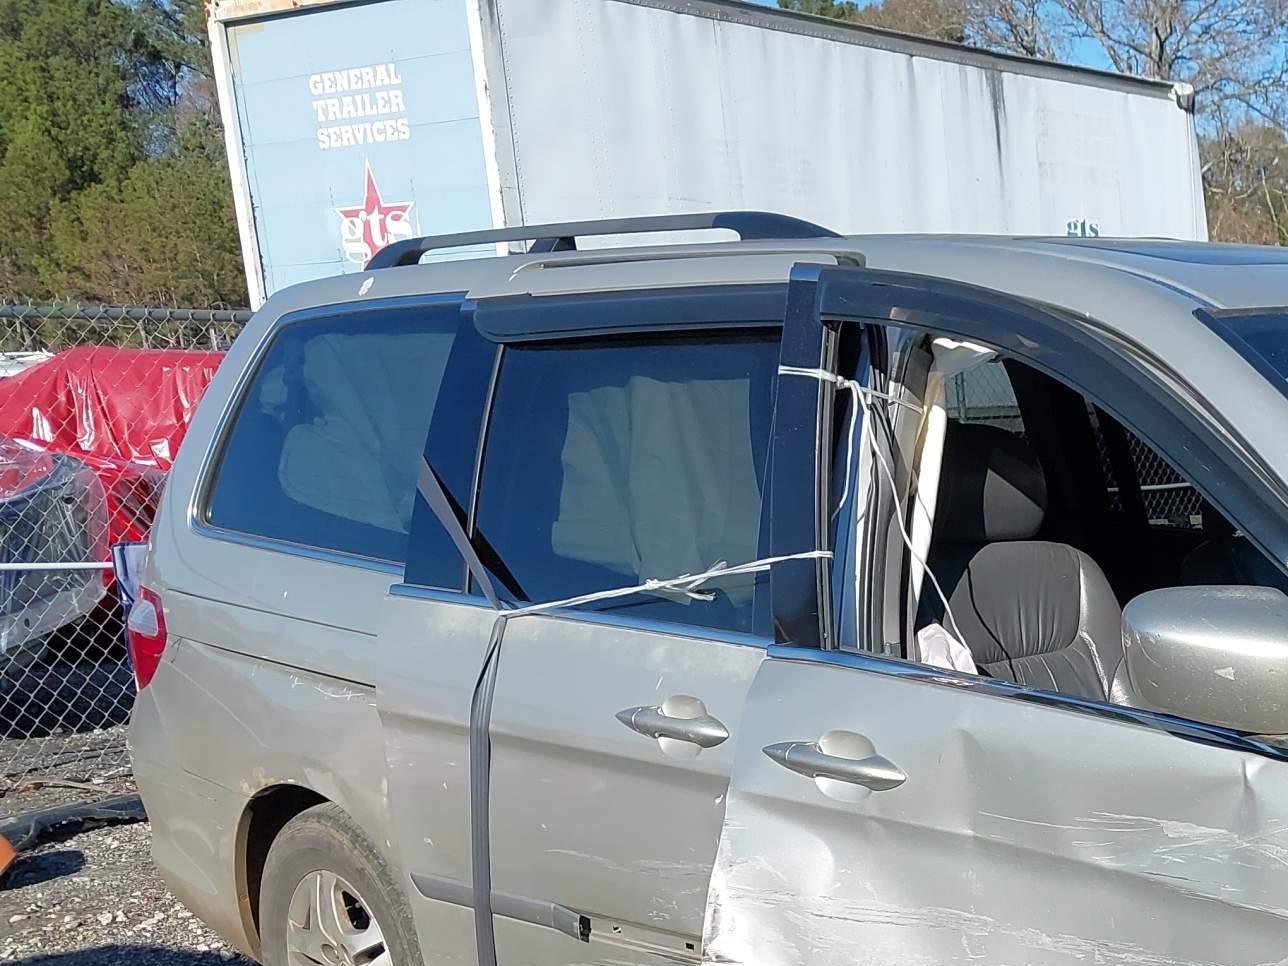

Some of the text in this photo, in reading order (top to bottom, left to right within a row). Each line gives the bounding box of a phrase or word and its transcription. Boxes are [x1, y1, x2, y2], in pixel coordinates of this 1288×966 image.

[309, 63, 402, 95] GENERAL
[312, 90, 406, 122] TRAILER
[317, 118, 410, 148] SERVICES
